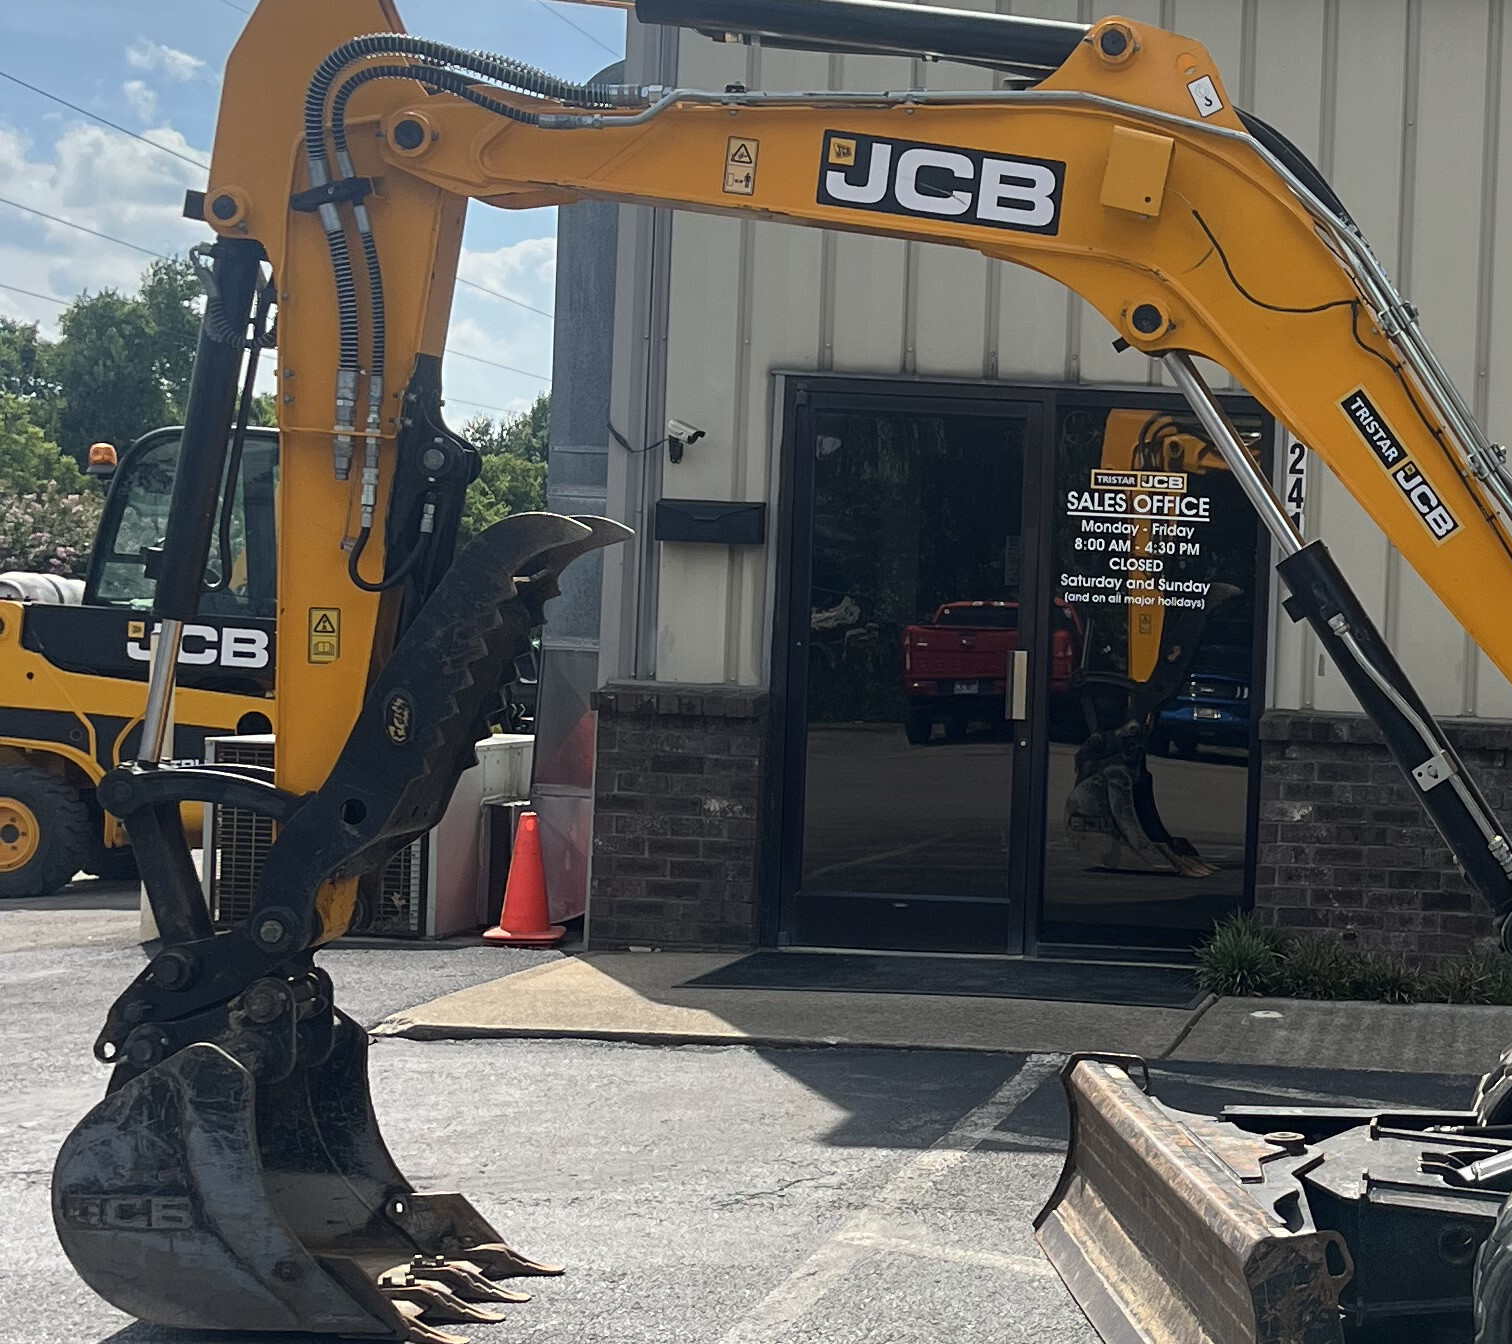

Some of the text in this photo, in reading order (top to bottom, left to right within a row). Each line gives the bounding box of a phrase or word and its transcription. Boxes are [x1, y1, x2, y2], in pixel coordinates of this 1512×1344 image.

[826, 143, 1056, 227] JCB
[1350, 397, 1453, 537] TRISTAR JCB
[1097, 475, 1183, 488] TRISTAR JCB
[1067, 491, 1210, 516] SALES OFFICE
[1081, 519, 1139, 536] Monday
[1152, 523, 1195, 539] Friday
[1074, 538, 1105, 551] 8:00
[1108, 539, 1131, 552] AM
[1144, 541, 1175, 554] 4:30
[1179, 543, 1200, 555] PM
[1109, 558, 1163, 572] CLOSED
[1060, 574, 1210, 595] Saturday and Sunday
[1064, 592, 1205, 610] (and on all major holidays)
